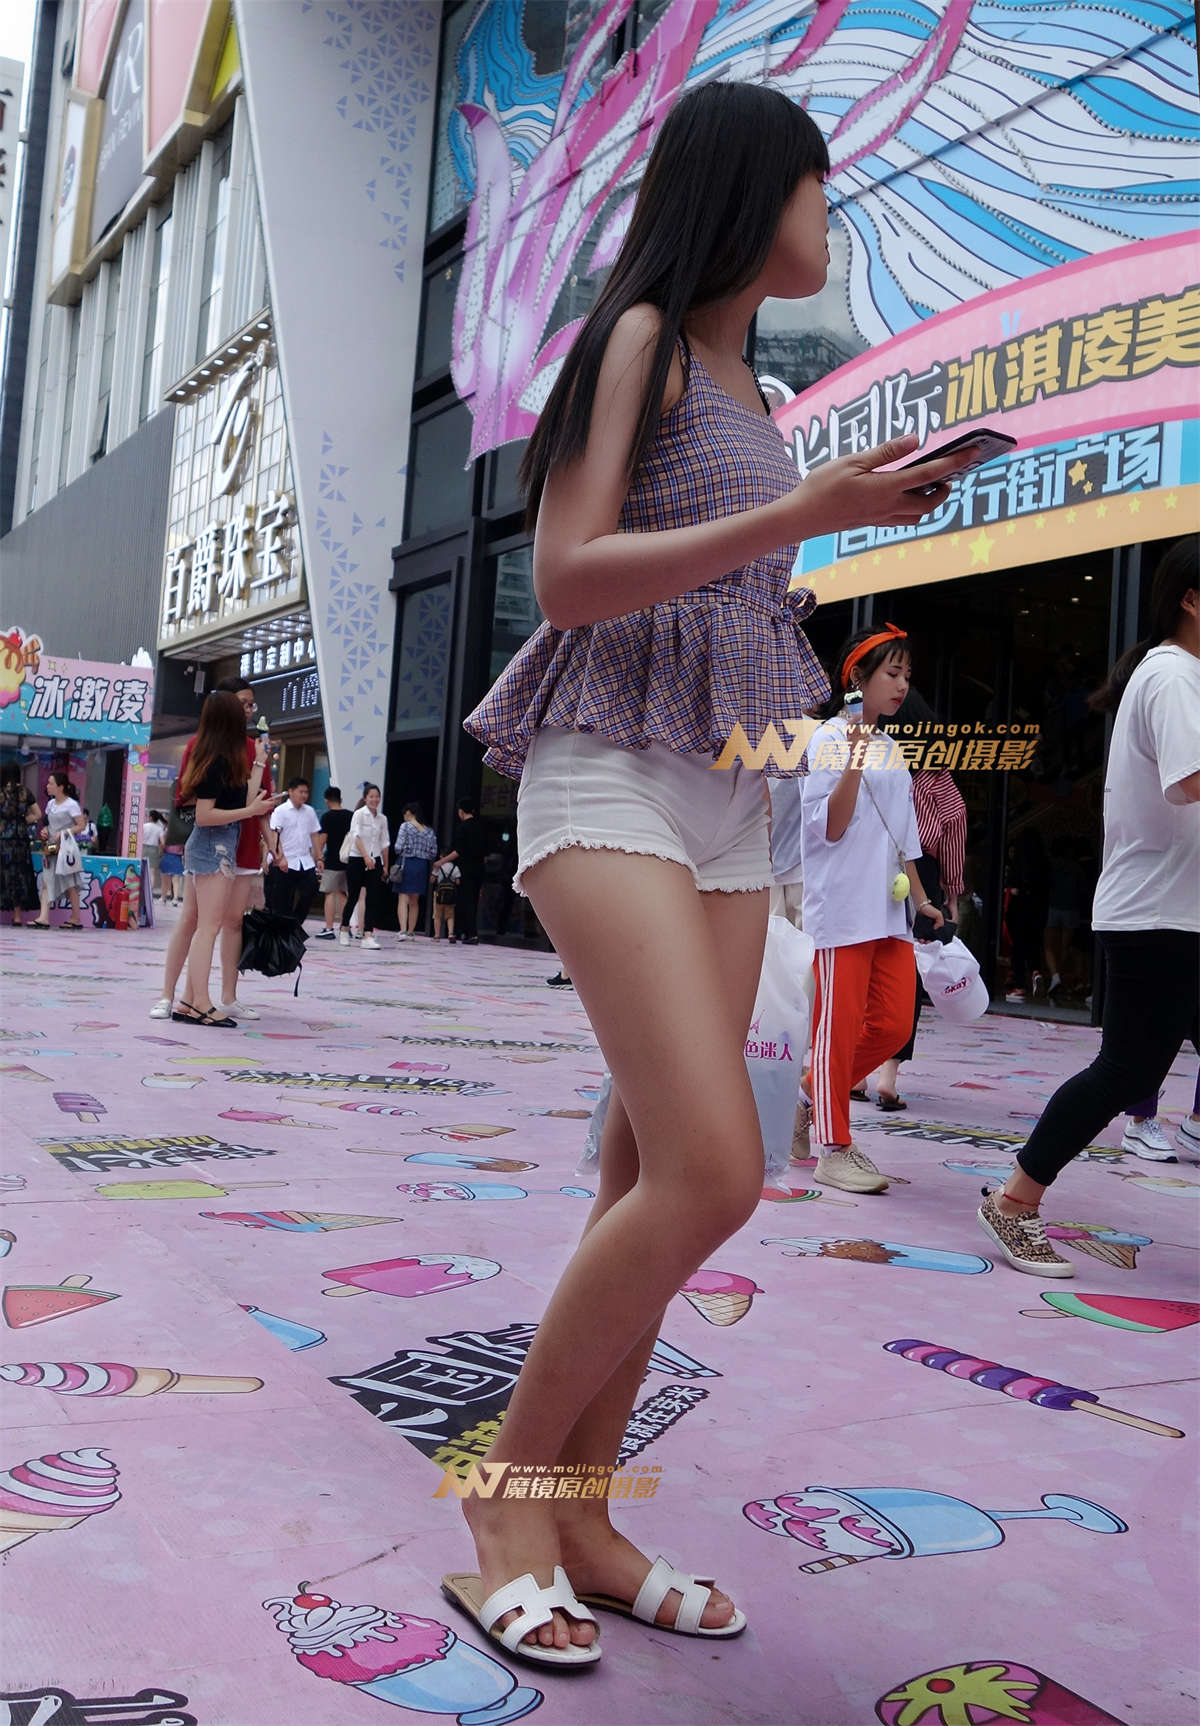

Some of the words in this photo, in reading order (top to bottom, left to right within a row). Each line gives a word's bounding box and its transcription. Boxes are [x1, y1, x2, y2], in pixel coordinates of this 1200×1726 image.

[163, 490, 290, 625] 百爵珠宝
[28, 676, 148, 723] 冰激凌
[745, 1040, 793, 1062] 色迷人
